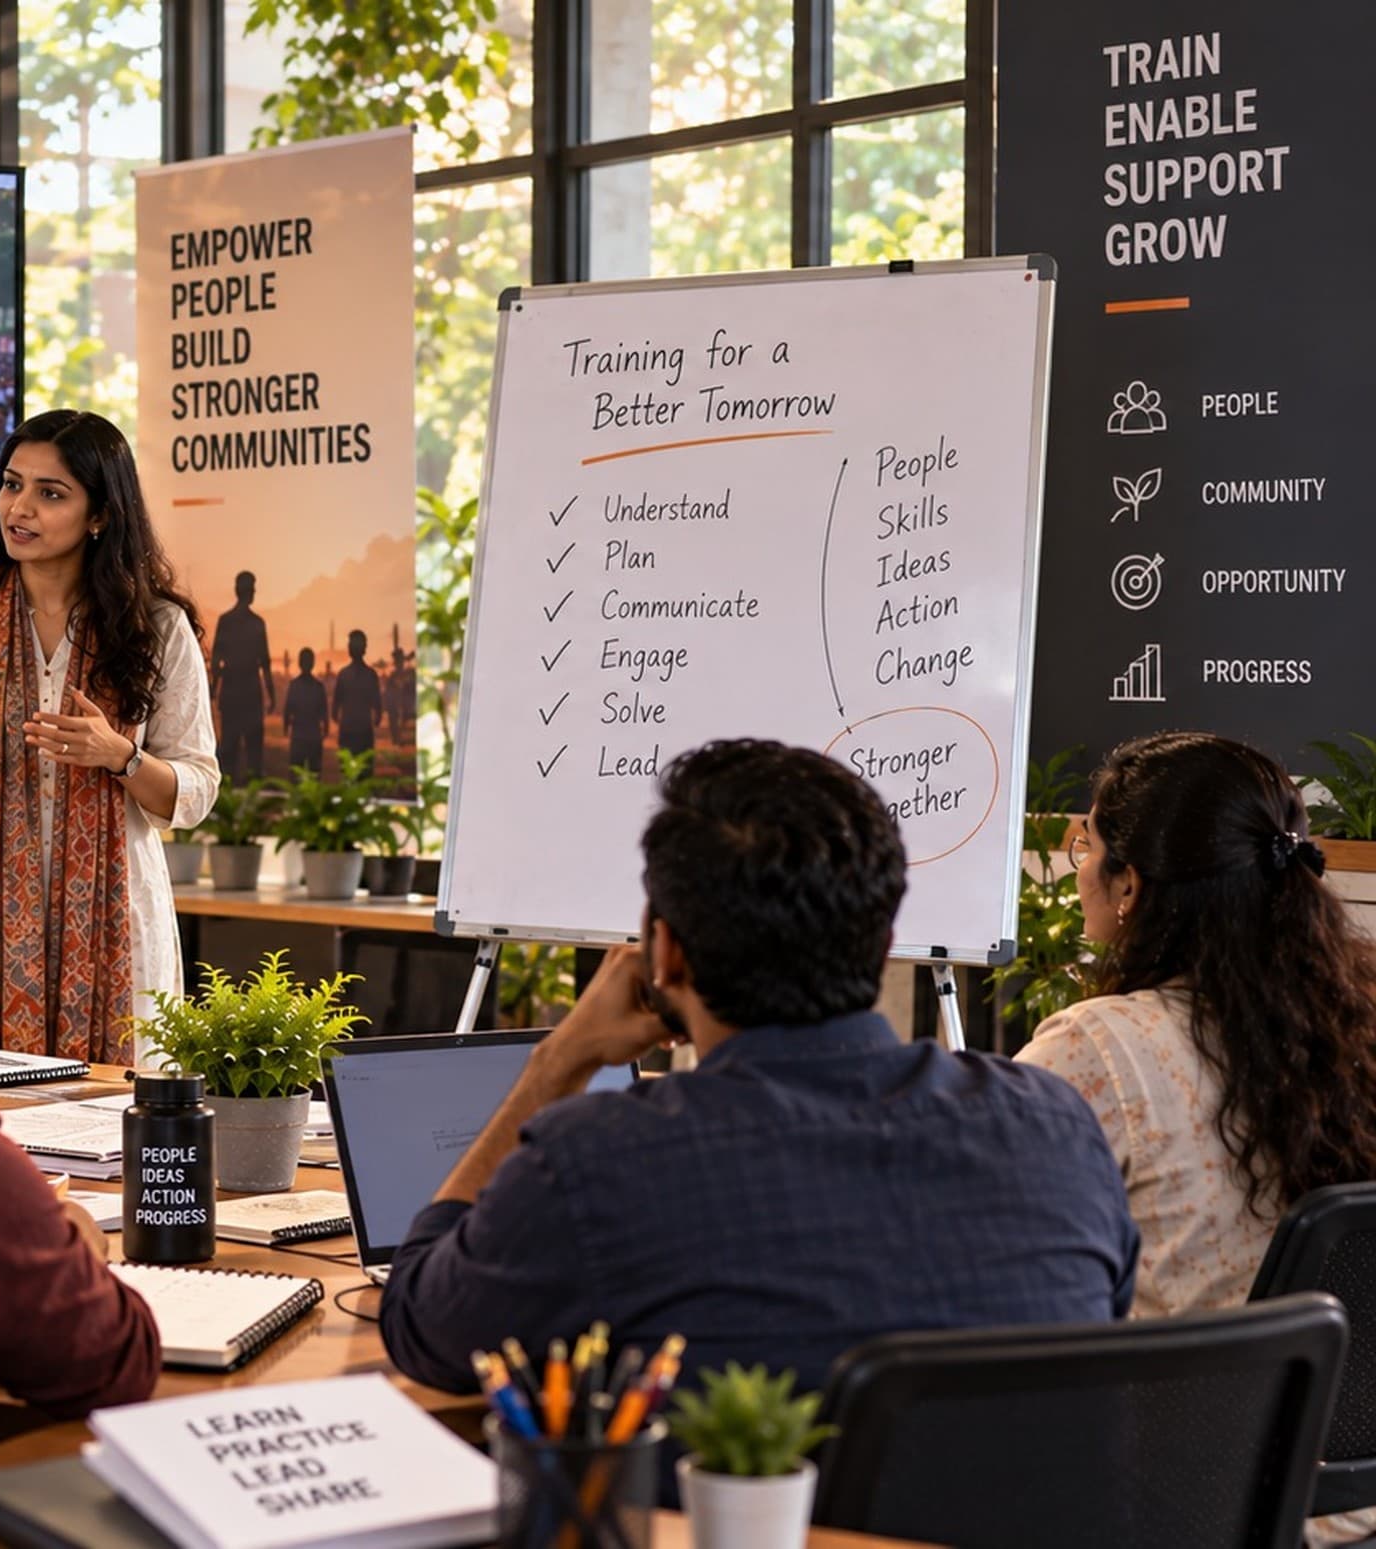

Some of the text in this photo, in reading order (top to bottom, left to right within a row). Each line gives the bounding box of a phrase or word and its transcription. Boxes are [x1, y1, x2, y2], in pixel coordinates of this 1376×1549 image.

[1104, 33, 1219, 86] TRAIN
[1106, 89, 1256, 146] ENABLE
[1104, 146, 1289, 206] SUPPORT
[171, 218, 312, 270] EMPOWER
[1106, 215, 1226, 265] GROW
[172, 272, 276, 319] PEOPLE
[172, 328, 250, 370] BUILD
[564, 329, 789, 386] Training for a
[172, 373, 319, 420] STRONGER
[593, 386, 835, 430] Better Tomorrow
[1203, 392, 1278, 417] PEOPLE
[172, 423, 370, 472] COMMUNITIES
[876, 435, 958, 487] People
[605, 488, 730, 522] Understand
[1203, 478, 1325, 504] COMMUNITY
[878, 495, 948, 539] Skills
[606, 540, 654, 570] Plan
[877, 550, 950, 587] Ideas
[1203, 569, 1345, 593] OPPORTUNITY
[602, 589, 759, 620] Communicate
[876, 595, 958, 634] Action
[601, 639, 688, 682] Engage
[876, 646, 973, 686] Change
[1204, 660, 1311, 683] PROGRESS
[601, 692, 665, 724] Solve
[598, 744, 658, 778] Lead
[850, 741, 957, 782] Stronger
[887, 784, 966, 823] gether
[142, 1147, 196, 1163] PEOPLE
[142, 1168, 184, 1183] IDEAS
[142, 1189, 195, 1204] ACTION
[136, 1209, 206, 1225] PROGRESS
[185, 1406, 304, 1439] LEARN
[207, 1421, 377, 1464] PRACTICE
[231, 1459, 326, 1490] LEAD
[256, 1478, 381, 1516] SHARE
